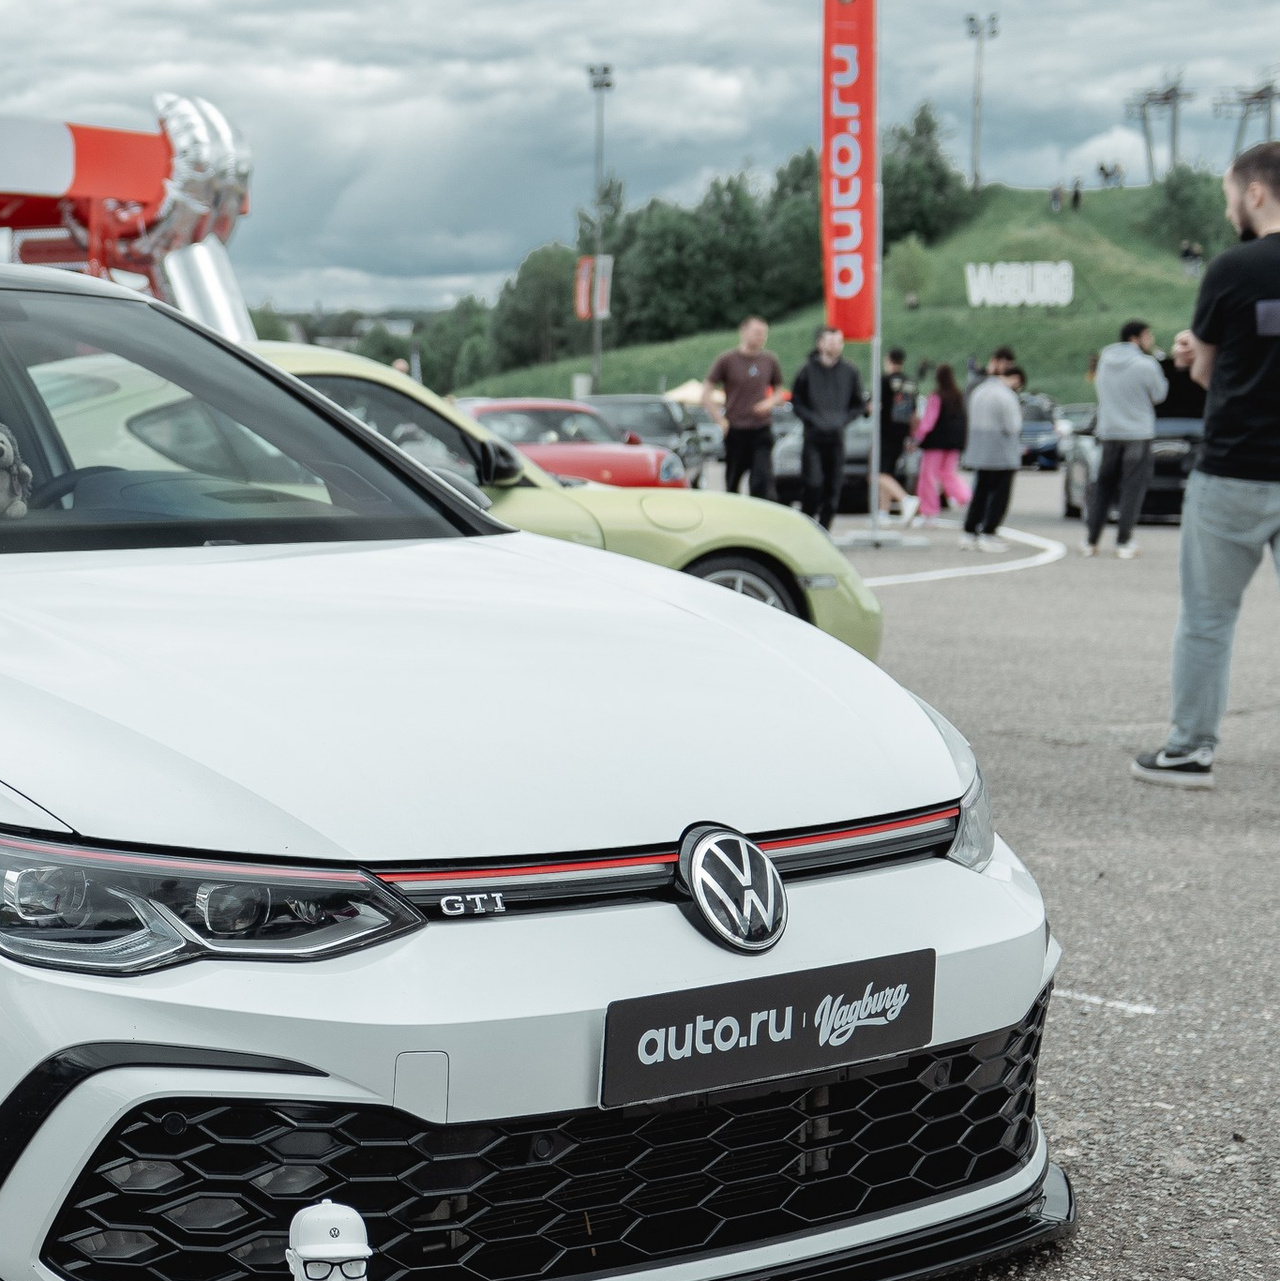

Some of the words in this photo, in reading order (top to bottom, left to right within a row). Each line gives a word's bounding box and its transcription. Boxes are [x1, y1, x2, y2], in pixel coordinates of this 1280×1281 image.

[440, 892, 507, 916] GTI
[638, 1005, 793, 1065] auto.ru
[815, 982, 911, 1047] Vagburg
